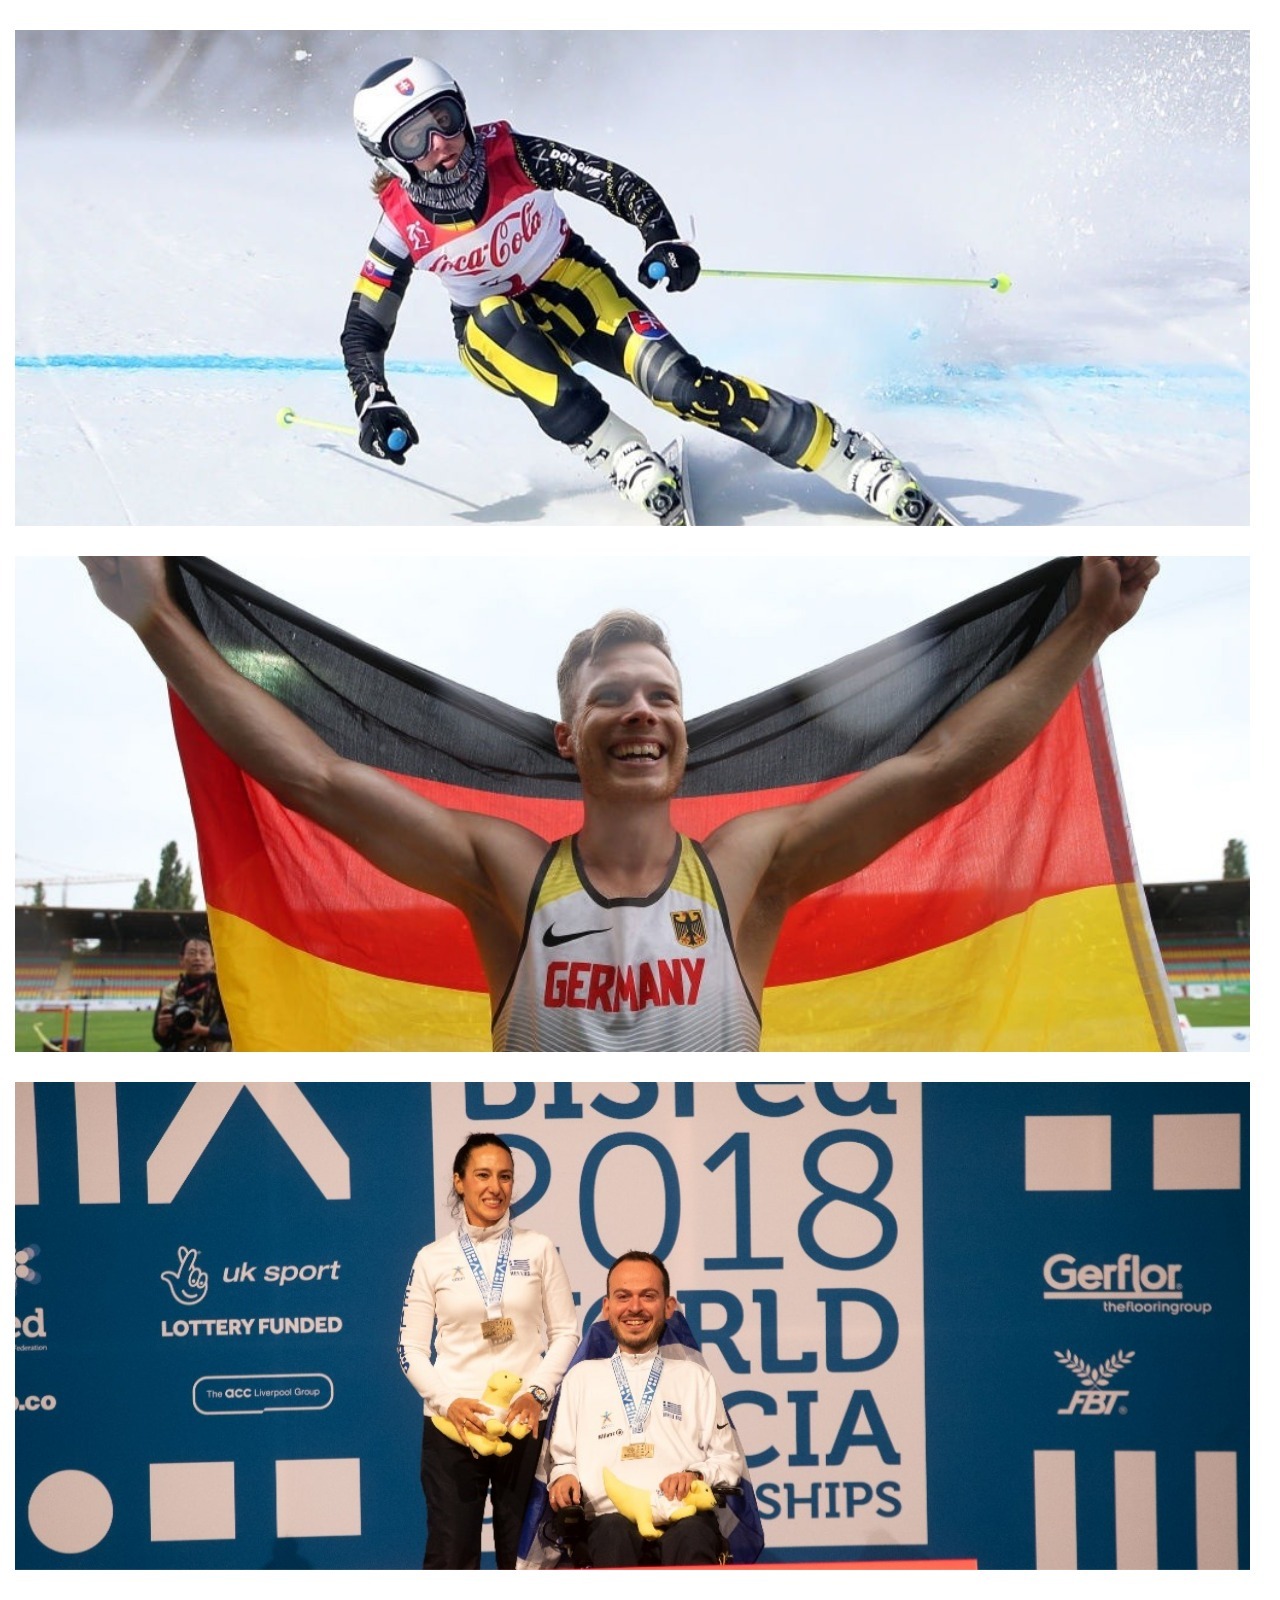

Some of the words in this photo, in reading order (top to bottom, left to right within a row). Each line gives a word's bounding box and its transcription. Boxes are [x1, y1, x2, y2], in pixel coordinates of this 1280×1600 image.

[544, 958, 705, 1012] GERMANY
[222, 1261, 257, 1283] uk
[263, 1260, 341, 1286] sport
[1043, 1253, 1183, 1292] Gerflor
[161, 1318, 255, 1337] LOTTERY
[258, 1316, 343, 1335] FUNDED
[206, 1389, 223, 1399] The
[225, 1388, 252, 1399] acc
[254, 1387, 292, 1400] Liverpool
[294, 1387, 320, 1400] Group
